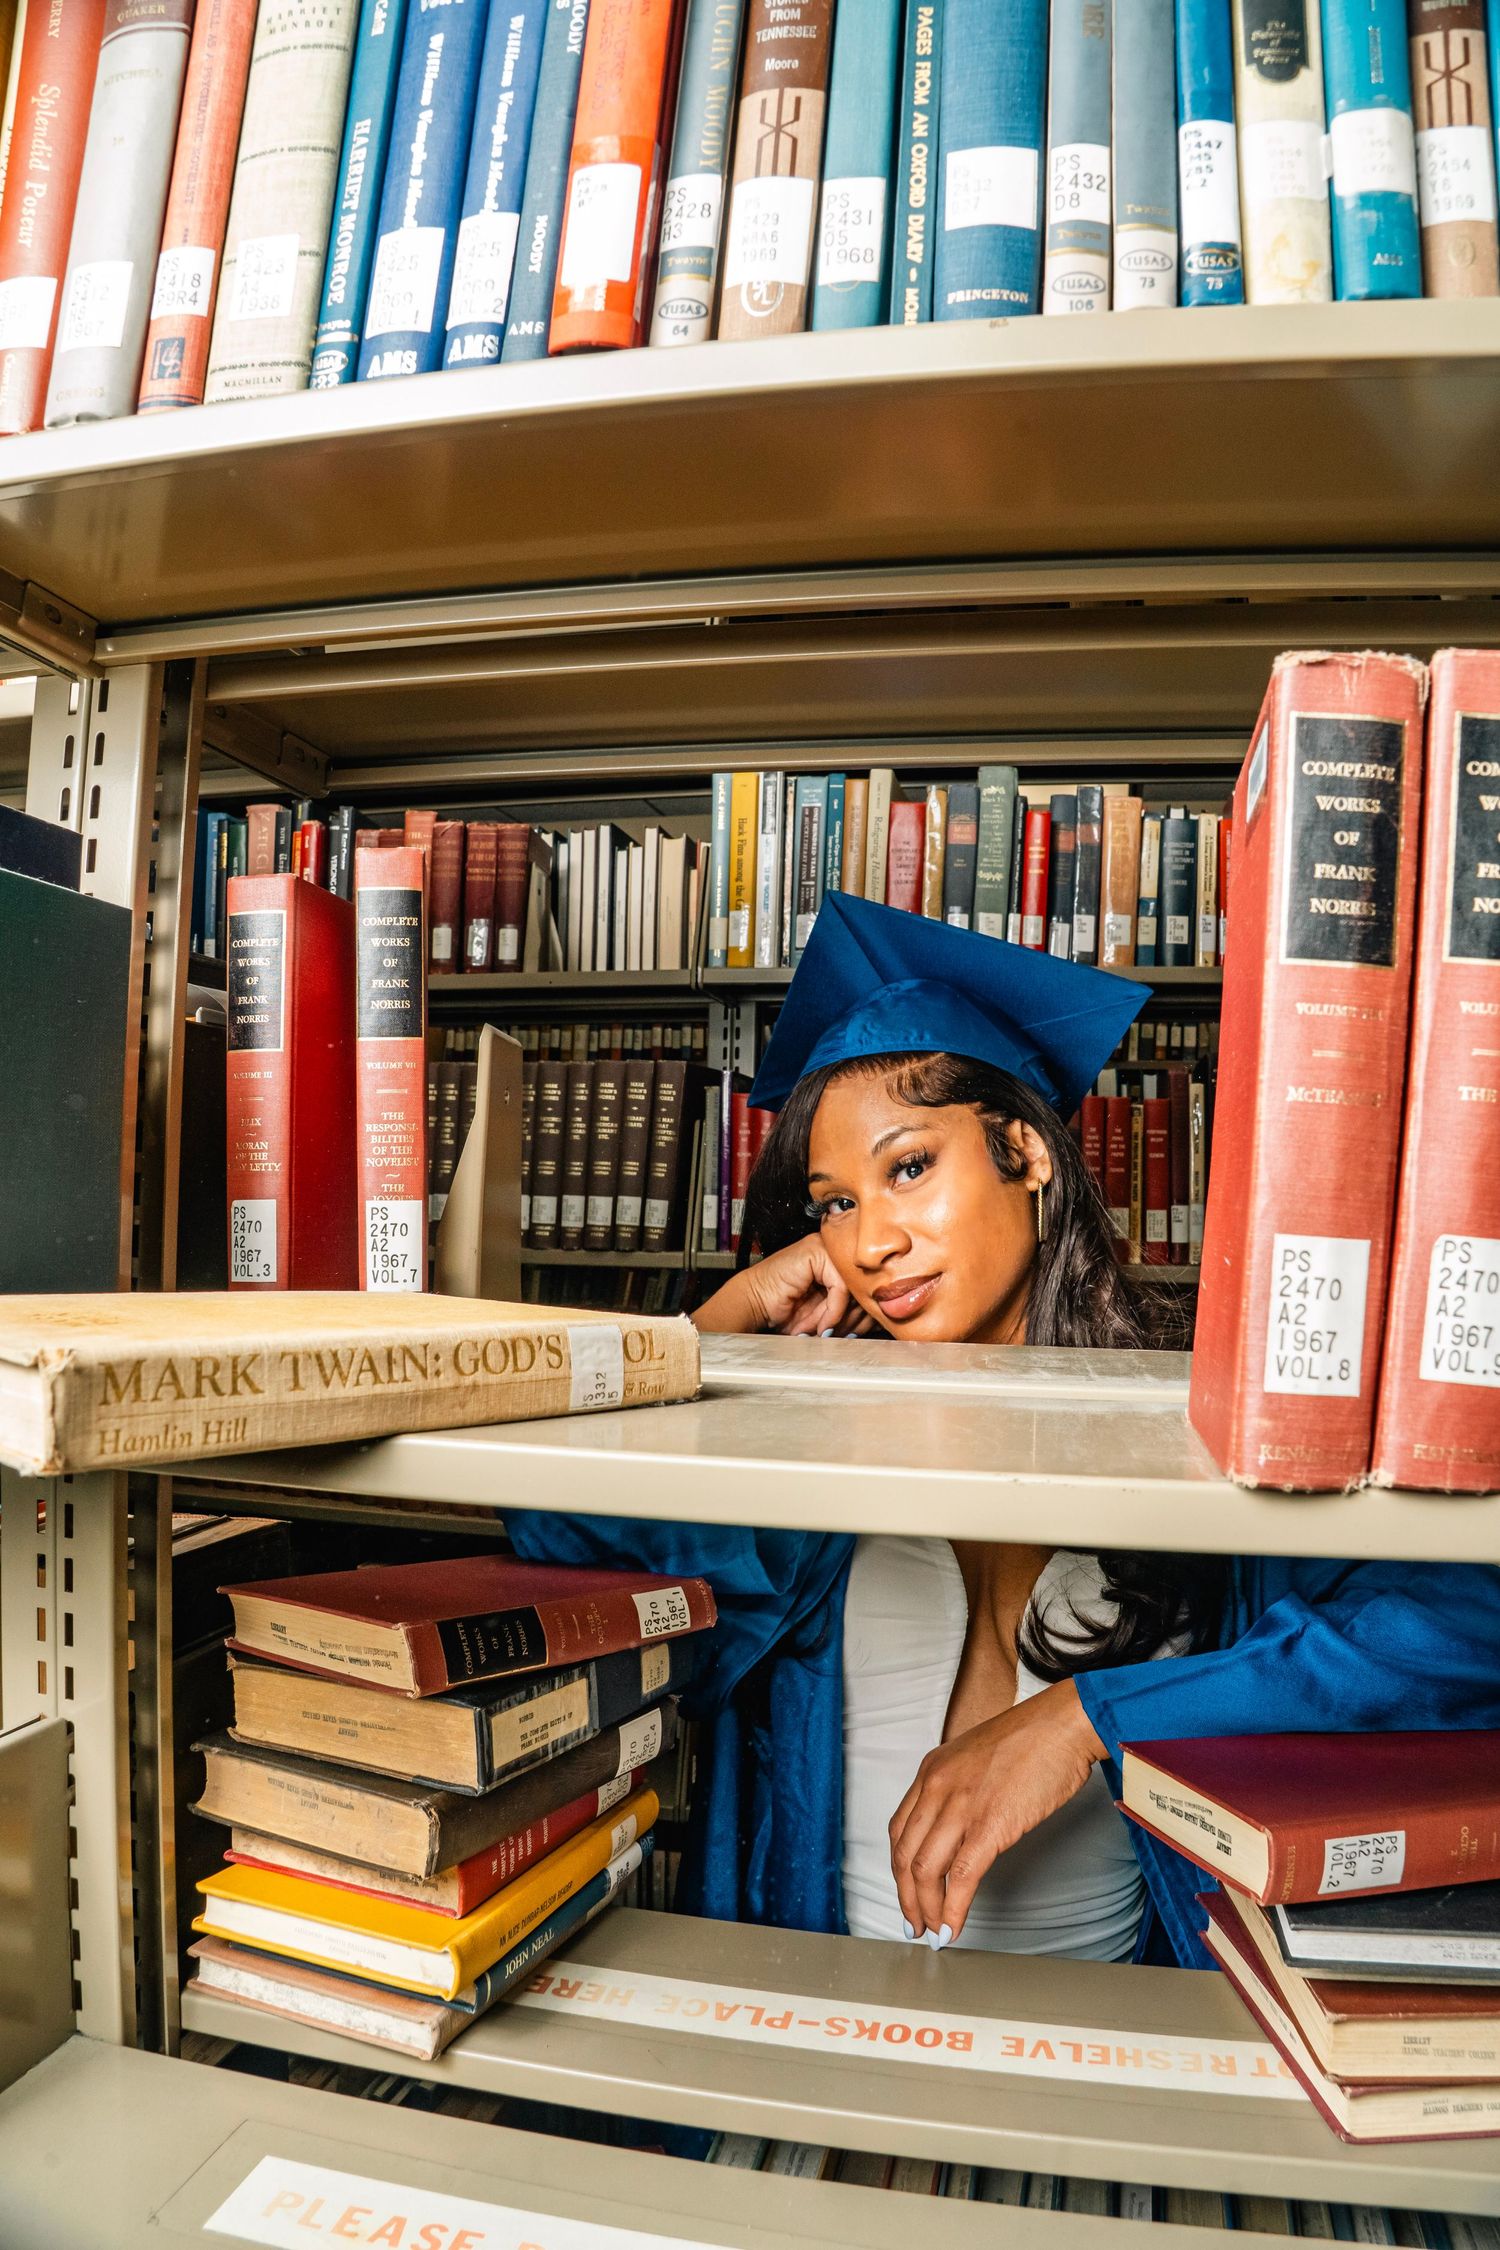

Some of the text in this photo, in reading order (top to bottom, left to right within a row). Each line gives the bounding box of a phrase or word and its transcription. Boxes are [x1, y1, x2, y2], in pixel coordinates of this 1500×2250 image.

[117, 4, 166, 22] QUAKER
[769, 8, 801, 21] FROM
[756, 25, 817, 44] TENNESSEE
[764, 58, 799, 73] Moore
[33, 83, 62, 171] Splendid
[699, 84, 726, 174] MOODY
[906, 6, 934, 264] PAGES FROM AN OXFORD DIARY
[1055, 154, 1081, 172] PS
[1054, 171, 1107, 193] 2432
[667, 187, 687, 208] PS
[825, 193, 850, 211] PS
[1054, 192, 1081, 211] D8
[327, 118, 371, 307] HARRIET MONROE
[662, 202, 712, 225] 2428
[824, 210, 873, 228] 2431
[661, 223, 683, 243] H3
[528, 214, 549, 274] MOODY
[824, 247, 875, 267] 1968
[1126, 256, 1168, 269] TUSAS
[1060, 277, 1100, 291] TUSAS
[1139, 276, 1156, 289] 73
[1205, 277, 1224, 291] 73
[946, 288, 1030, 304] PRINCETON
[663, 304, 702, 317] TUSAS
[508, 320, 545, 336] AMS
[672, 325, 689, 337] 64
[447, 333, 500, 364] AMS
[366, 350, 418, 379] AMS
[224, 375, 282, 388] MACMILLAN
[1301, 760, 1396, 781] COMPLETE
[1315, 795, 1381, 814] WORKS
[1333, 830, 1360, 846] OF
[735, 817, 748, 898] Huck Finn among the
[1313, 863, 1377, 882] FRANK
[1309, 897, 1377, 916] NORRIS
[362, 917, 419, 928] COMPLETE
[232, 937, 279, 948] COMPLETE
[370, 937, 410, 947] WORKS
[237, 957, 271, 967] WORKS
[383, 958, 398, 967] OF
[246, 976, 260, 986] OF
[371, 979, 410, 989] FRANK
[237, 995, 269, 1006] FRANK
[370, 999, 411, 1010] NORRIS
[1295, 1002, 1358, 1018] VOLUME
[236, 1014, 270, 1025] NORRIS
[365, 1061, 404, 1070] VOLUME
[1458, 1085, 1498, 1103] THE
[380, 1111, 405, 1121] THE
[370, 1135, 415, 1144] BILITIES
[248, 1152, 269, 1161] THE
[372, 1146, 414, 1155] OF THE
[249, 1162, 281, 1172] LETTY
[365, 1157, 420, 1167] NOVELIST
[381, 1183, 405, 1193] THE
[234, 1206, 246, 1219] PS
[370, 1206, 389, 1221] PS
[233, 1220, 262, 1234] 2470
[370, 1223, 409, 1237] 2470
[233, 1236, 246, 1249] A2
[371, 1238, 389, 1252] A2
[233, 1250, 262, 1263] 1967
[372, 1254, 409, 1268] 1967
[1281, 1249, 1311, 1273] PS
[1442, 1240, 1473, 1264] PS
[233, 1264, 271, 1277] VOL.3
[371, 1269, 418, 1283] VOL.7
[1279, 1274, 1343, 1301] 2470
[1439, 1266, 1500, 1294] 2470
[1278, 1302, 1308, 1326] A2
[1436, 1294, 1467, 1318] A2
[1280, 1328, 1337, 1354] 1967
[1437, 1322, 1495, 1349] 1967
[98, 1333, 564, 1406] MARK TWAIN: GOD'S
[1276, 1354, 1351, 1381] VOL.8
[639, 1380, 665, 1397] Row
[97, 1417, 248, 1456] Hamlin Hill
[650, 1601, 663, 1633] 2470
[666, 1599, 680, 1628] 1967
[672, 1591, 688, 1628] VOL.1
[644, 1618, 654, 1635] PS
[661, 1615, 671, 1631] A2
[474, 1626, 487, 1665] WORKS
[491, 1636, 499, 1650] OF
[514, 1619, 529, 1656] NORRIS
[456, 1621, 474, 1676] COMPLETE
[1358, 1838, 1371, 1858] A2
[1385, 1835, 1398, 1855] PS
[1343, 1842, 1358, 1878] 1967
[1370, 1836, 1386, 1876] 2470
[1327, 1843, 1345, 1889] VOL.2
[499, 1880, 574, 1949] AN ALICE DUNBAR-NELSON READER
[504, 1927, 556, 1980] JOHN NEAL
[524, 1975, 1238, 2077] RESHELVE BOOKS-PLACE HERE
[261, 2190, 486, 2250] PLEASE
